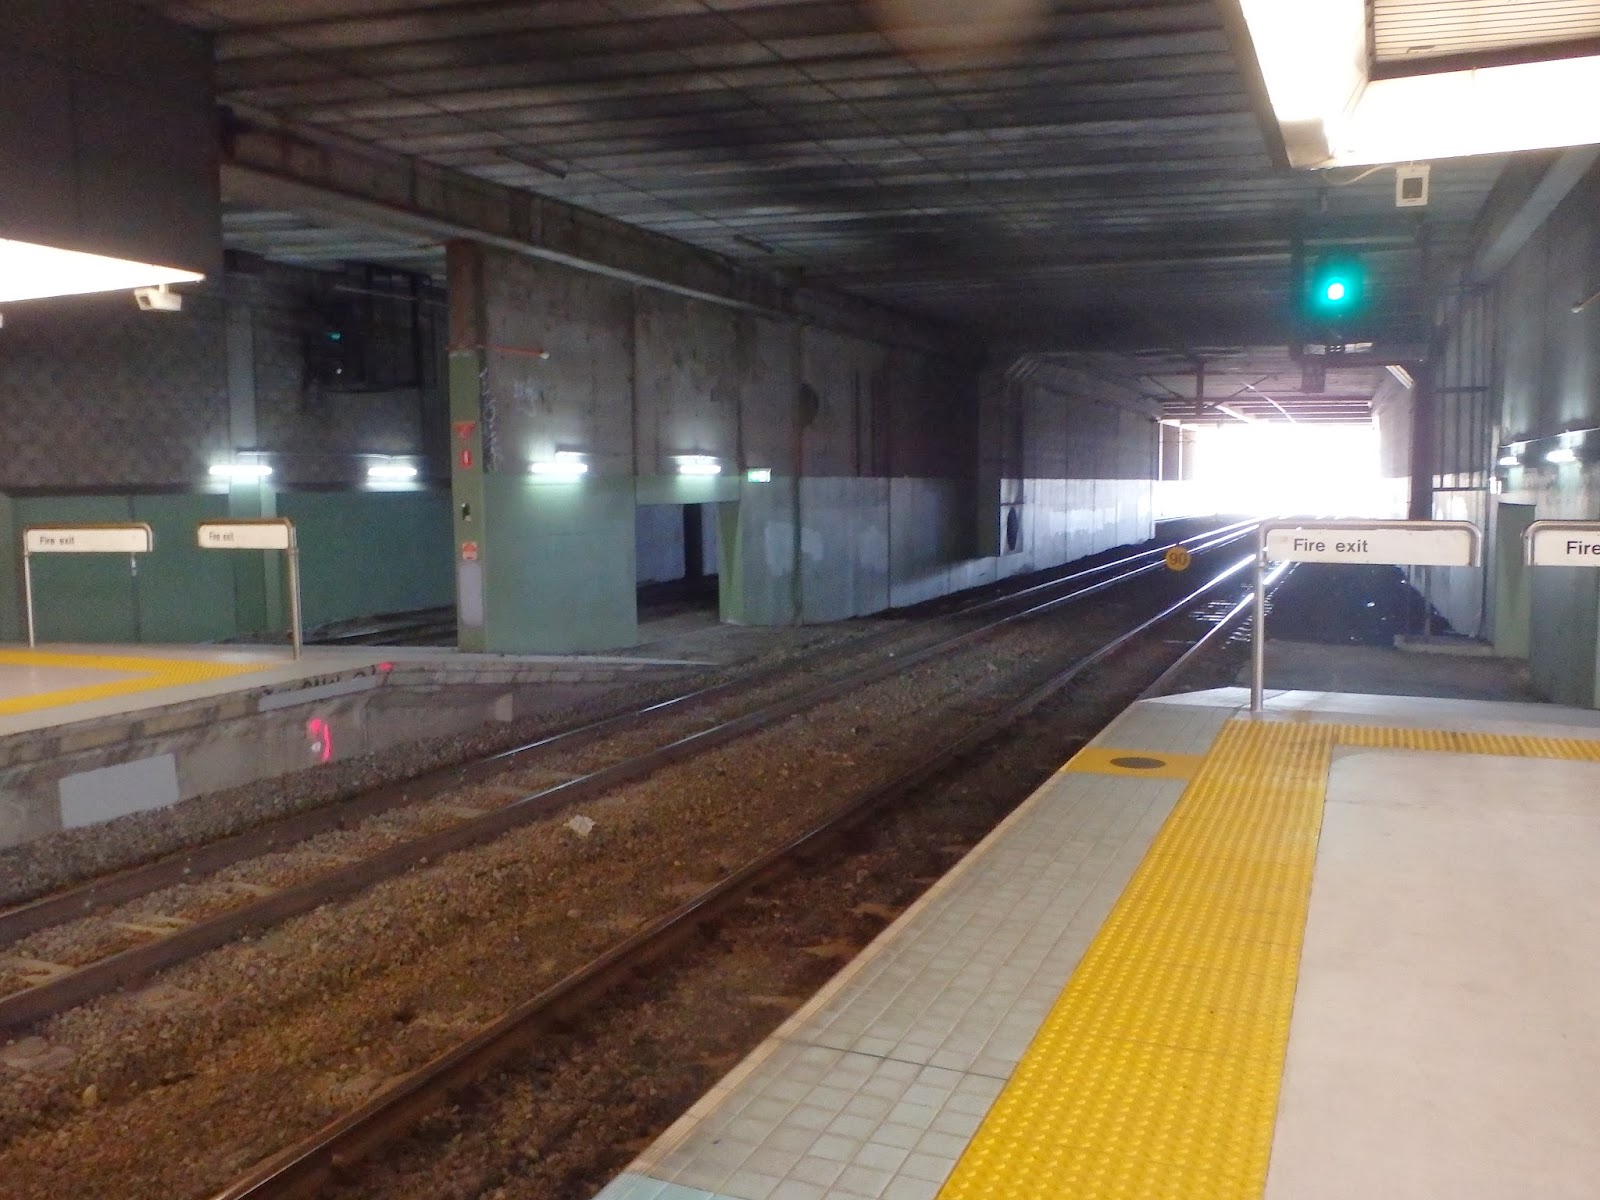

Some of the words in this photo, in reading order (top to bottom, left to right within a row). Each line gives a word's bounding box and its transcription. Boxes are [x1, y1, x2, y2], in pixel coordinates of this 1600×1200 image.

[40, 536, 55, 545] Fire
[59, 536, 75, 546] exit
[208, 531, 220, 541] Fire
[223, 532, 235, 541] exit
[1293, 538, 1326, 553] Fire
[1335, 539, 1369, 553] exit
[1566, 540, 1600, 555] Fire
[1169, 552, 1187, 566] 90
